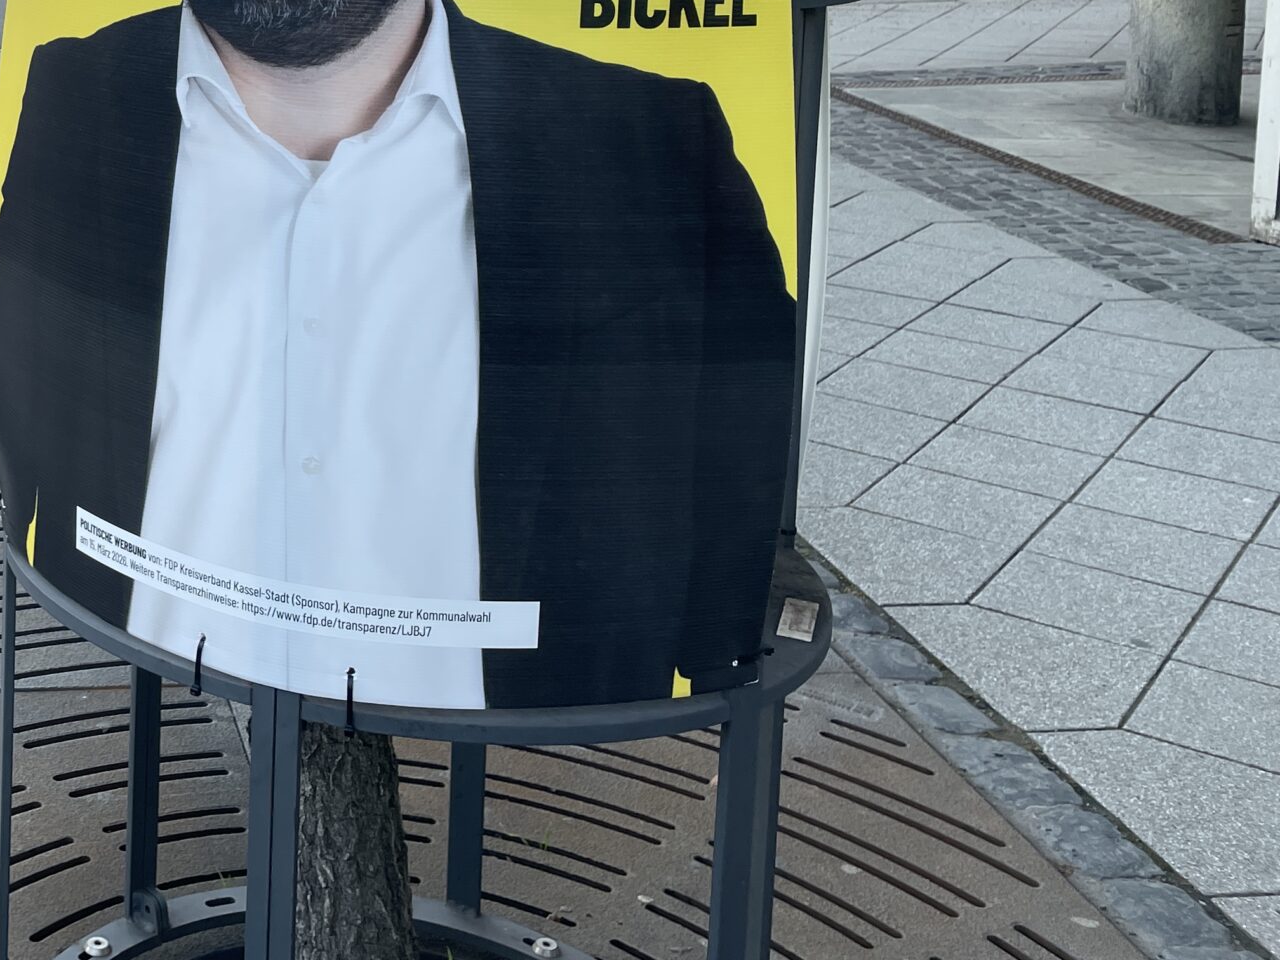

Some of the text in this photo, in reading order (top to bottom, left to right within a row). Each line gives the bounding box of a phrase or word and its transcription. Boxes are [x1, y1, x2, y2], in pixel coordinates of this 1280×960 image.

[80, 518, 113, 544] POLITISCHE
[114, 536, 147, 560] WERBUNG
[148, 553, 163, 566] von:
[164, 557, 179, 572] FDP
[180, 564, 232, 590] Kreisverband
[233, 580, 290, 604] Kassel-Stadt
[343, 602, 396, 620] Kampagne
[397, 610, 414, 619] zur
[416, 608, 492, 623] Kommunalwahl
[80, 536, 89, 545] am
[97, 541, 111, 558] März
[111, 550, 128, 567] 2026.
[130, 558, 155, 579] Weitere
[156, 570, 239, 608] Transparenzhinweise:
[241, 599, 432, 637] https://www.fdp.de/transparenz/LJBJ7
